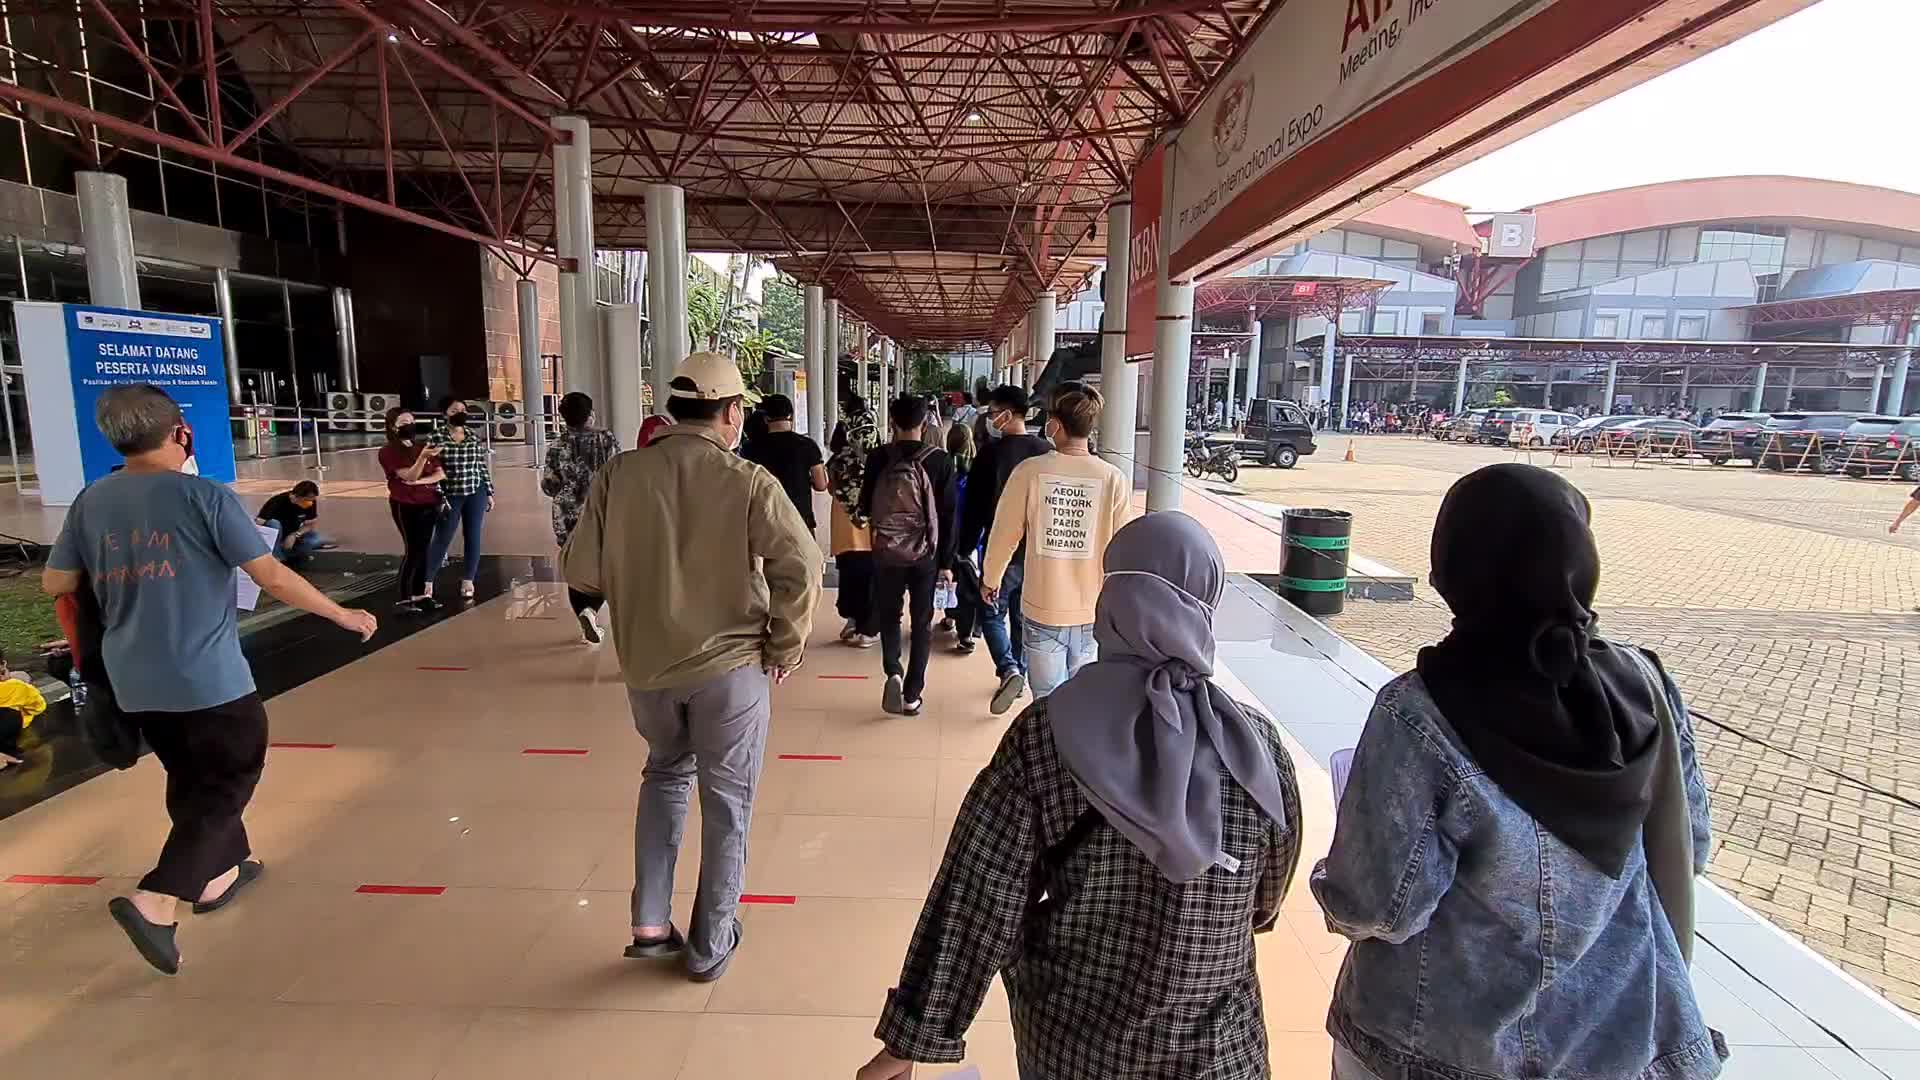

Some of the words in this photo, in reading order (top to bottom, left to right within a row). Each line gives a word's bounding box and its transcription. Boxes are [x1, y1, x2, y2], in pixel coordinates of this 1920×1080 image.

[1218, 127, 1285, 200] International
[1287, 104, 1323, 146] Expo
[1502, 224, 1521, 246] B
[98, 343, 153, 357] SELAMAT
[155, 346, 199, 360] DATANG
[96, 361, 150, 375] PESERTA
[151, 363, 207, 376] VAKSINASI
